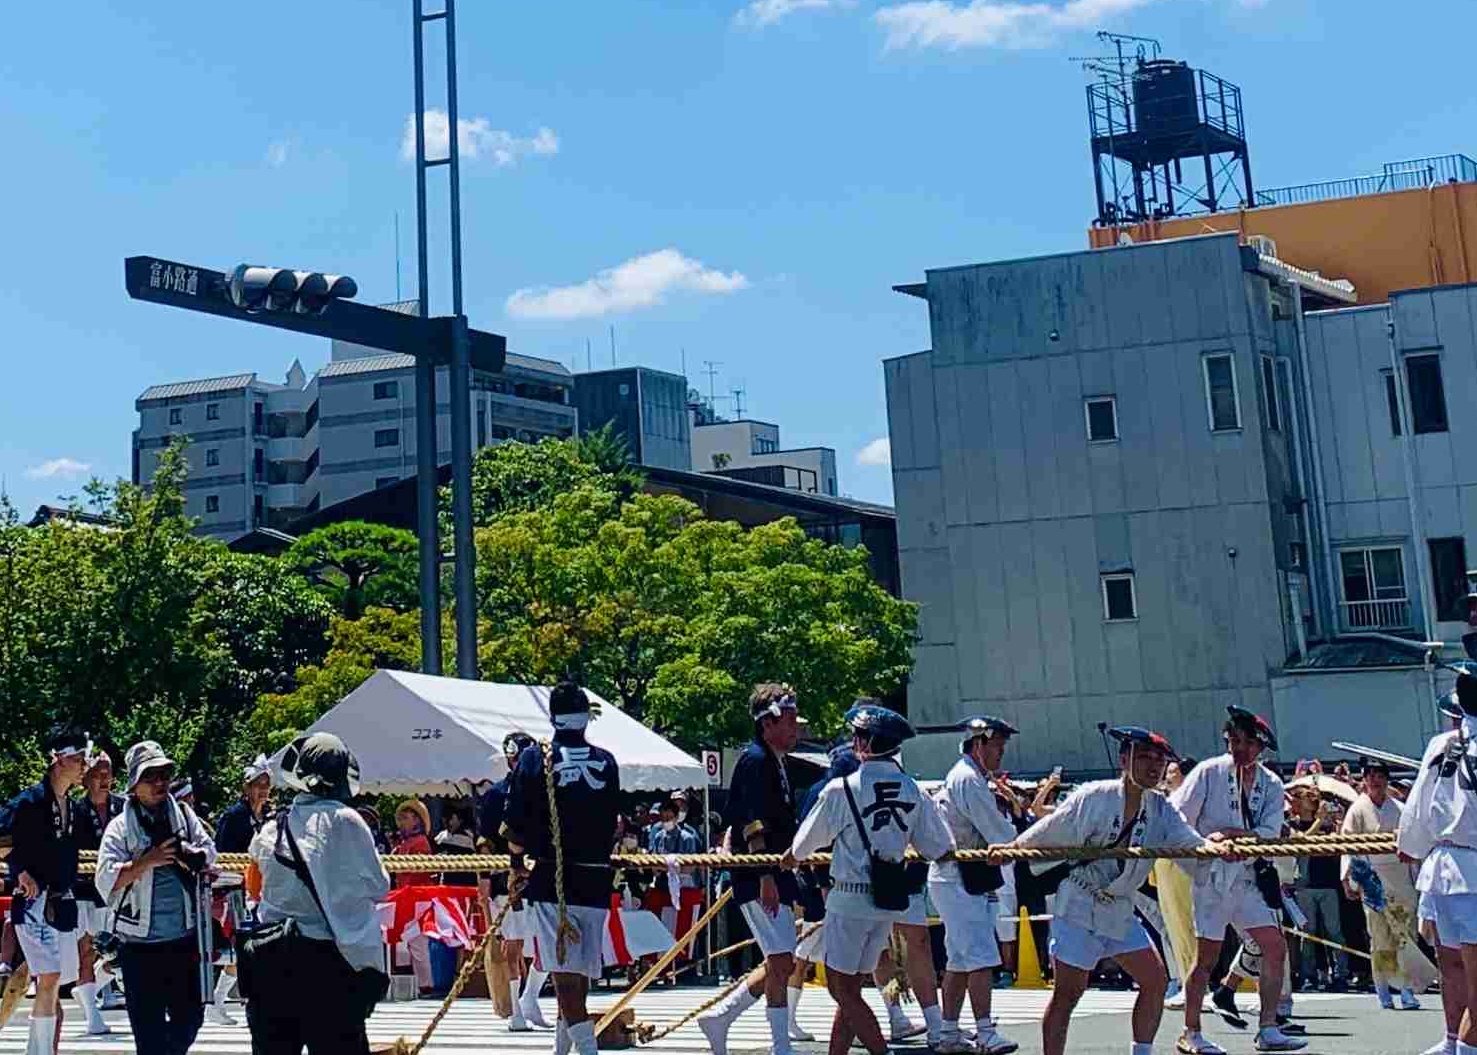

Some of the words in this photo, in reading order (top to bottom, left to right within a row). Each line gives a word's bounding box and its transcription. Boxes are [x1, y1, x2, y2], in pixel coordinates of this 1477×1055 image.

[149, 261, 198, 296] 富小路通
[861, 781, 917, 832] 長
